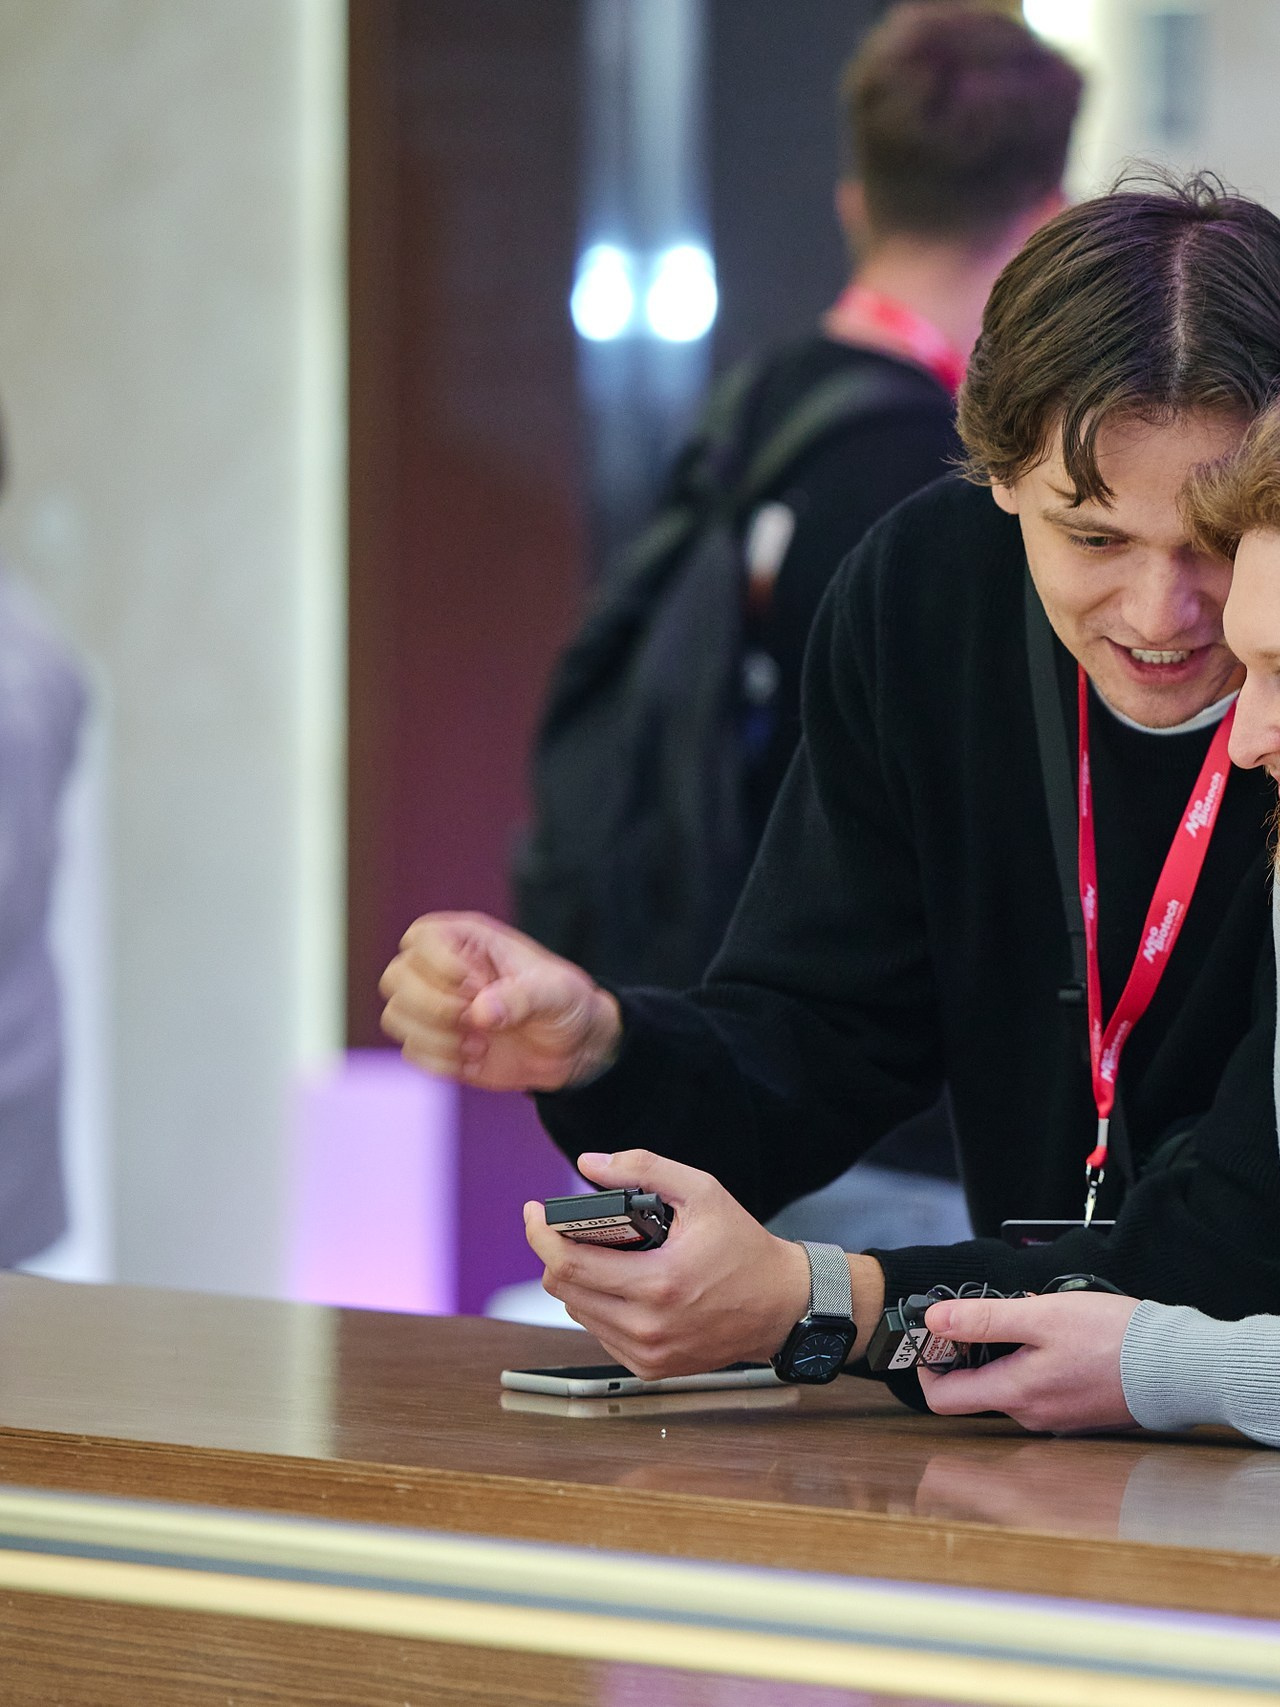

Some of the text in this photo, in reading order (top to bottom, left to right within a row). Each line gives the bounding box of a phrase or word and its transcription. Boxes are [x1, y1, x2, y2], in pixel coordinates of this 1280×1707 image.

[1197, 771, 1222, 827] Biotech
[1154, 899, 1180, 952] Biotech
[564, 1218, 617, 1229] 31-053
[572, 1226, 627, 1238] Congress
